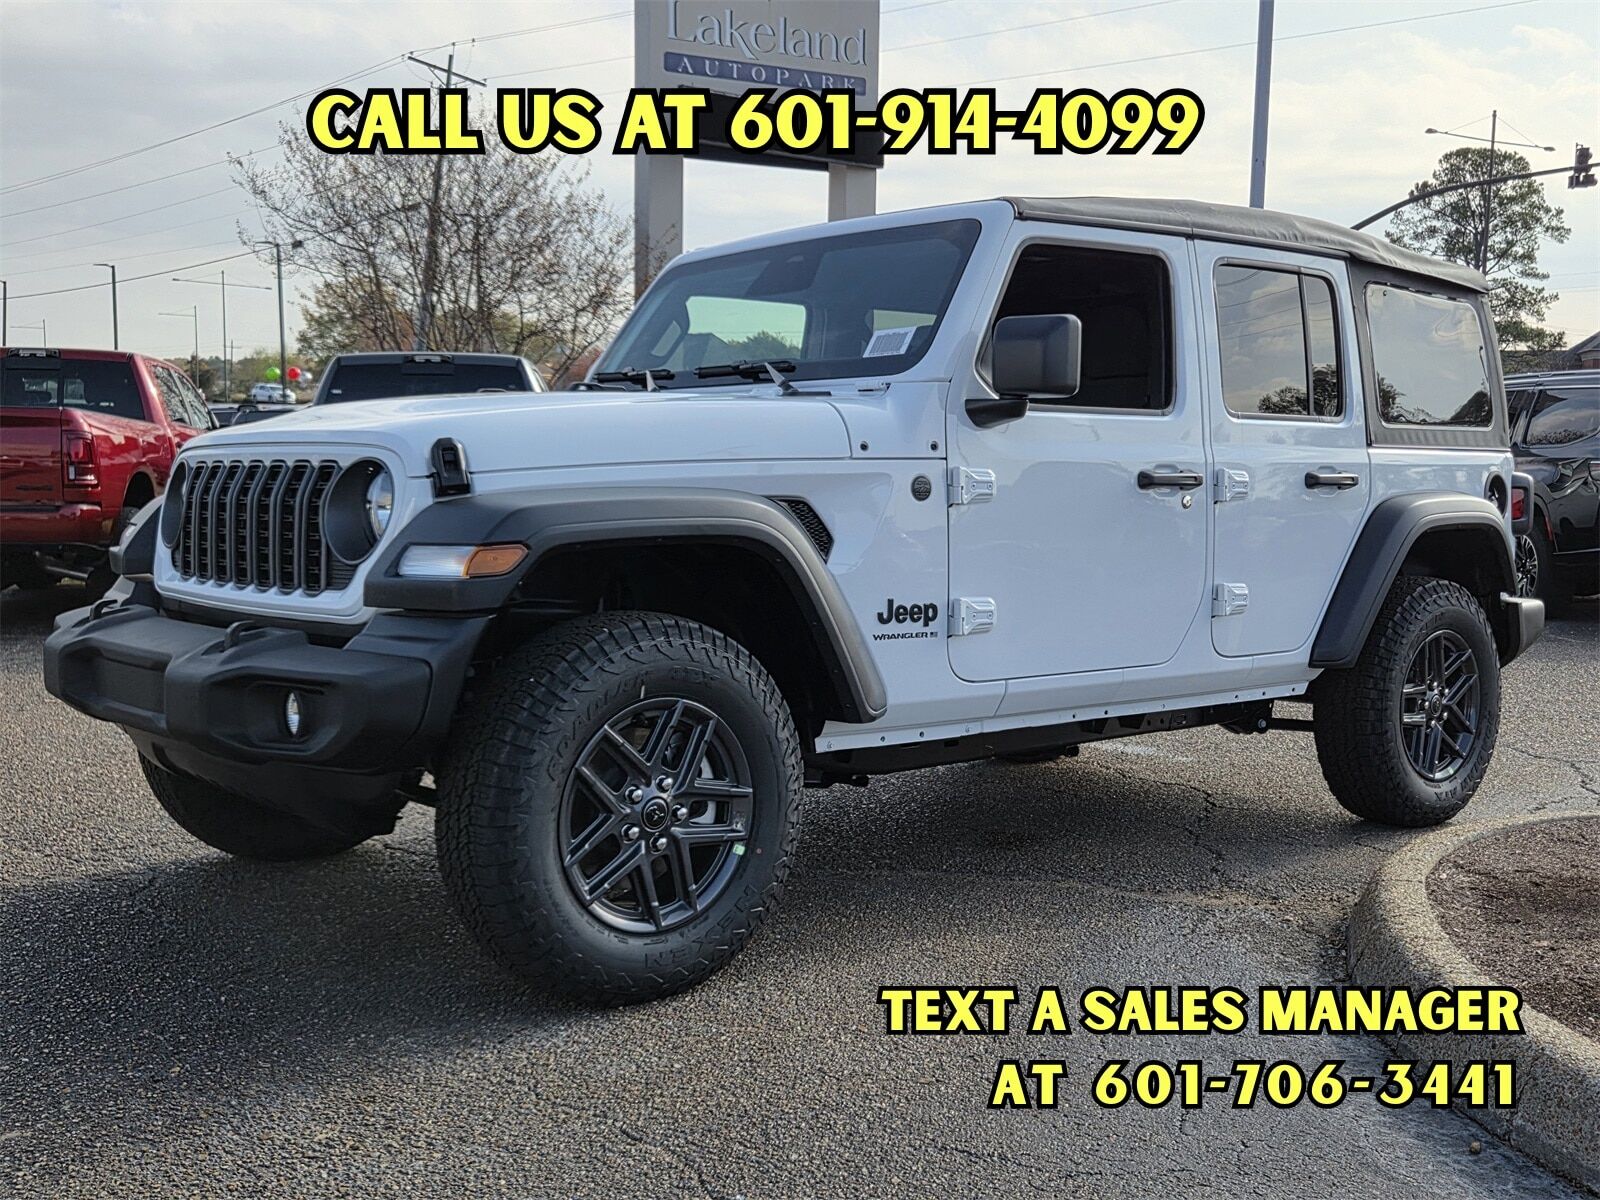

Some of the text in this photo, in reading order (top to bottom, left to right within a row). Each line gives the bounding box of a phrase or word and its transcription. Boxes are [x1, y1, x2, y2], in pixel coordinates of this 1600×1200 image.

[666, 0, 868, 66] Lakeland
[676, 56, 856, 90] AUTOPARK
[877, 598, 938, 627] Jeep
[872, 632, 929, 641] WRANGLER
